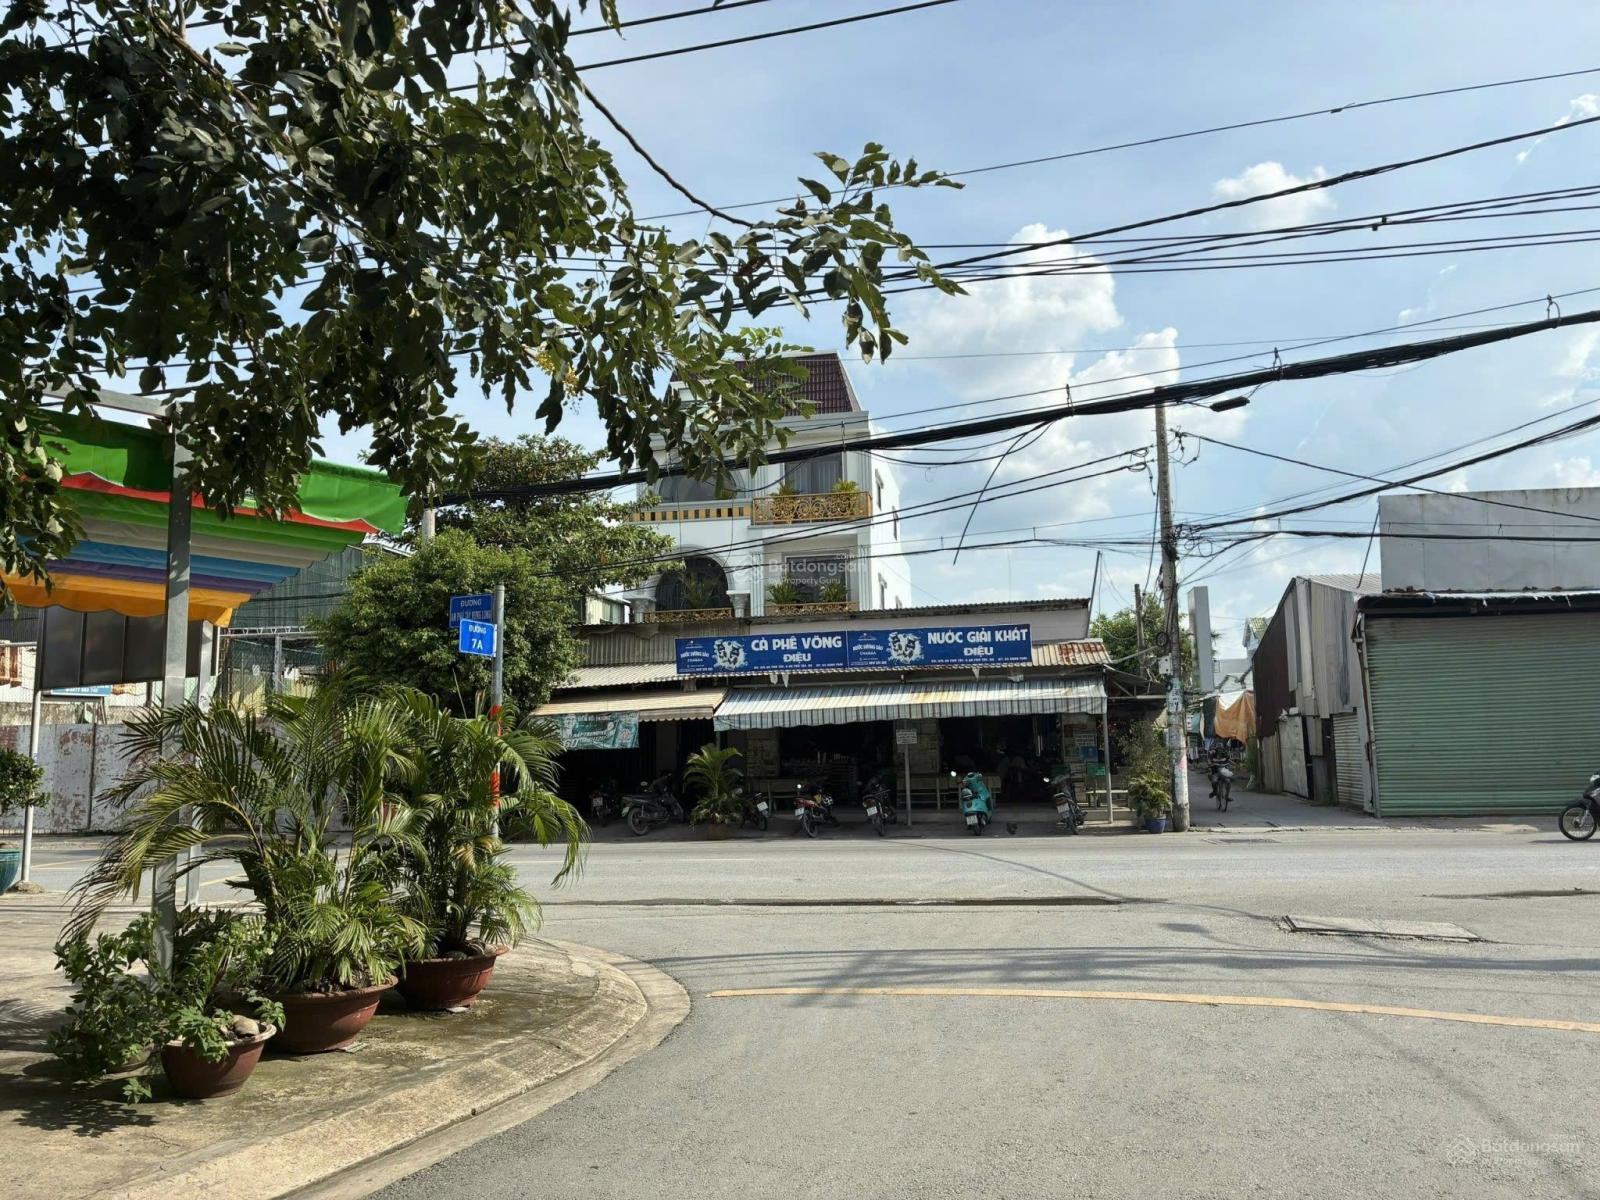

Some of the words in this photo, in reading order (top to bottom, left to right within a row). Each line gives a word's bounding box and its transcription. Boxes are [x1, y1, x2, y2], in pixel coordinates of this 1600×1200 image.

[751, 637, 769, 651] CÀ
[772, 636, 798, 651] PHÊ
[927, 629, 964, 645] NƯỚC
[966, 627, 992, 643] GIẢI
[994, 627, 1028, 642] KHÁT
[471, 638, 483, 650] 7A
